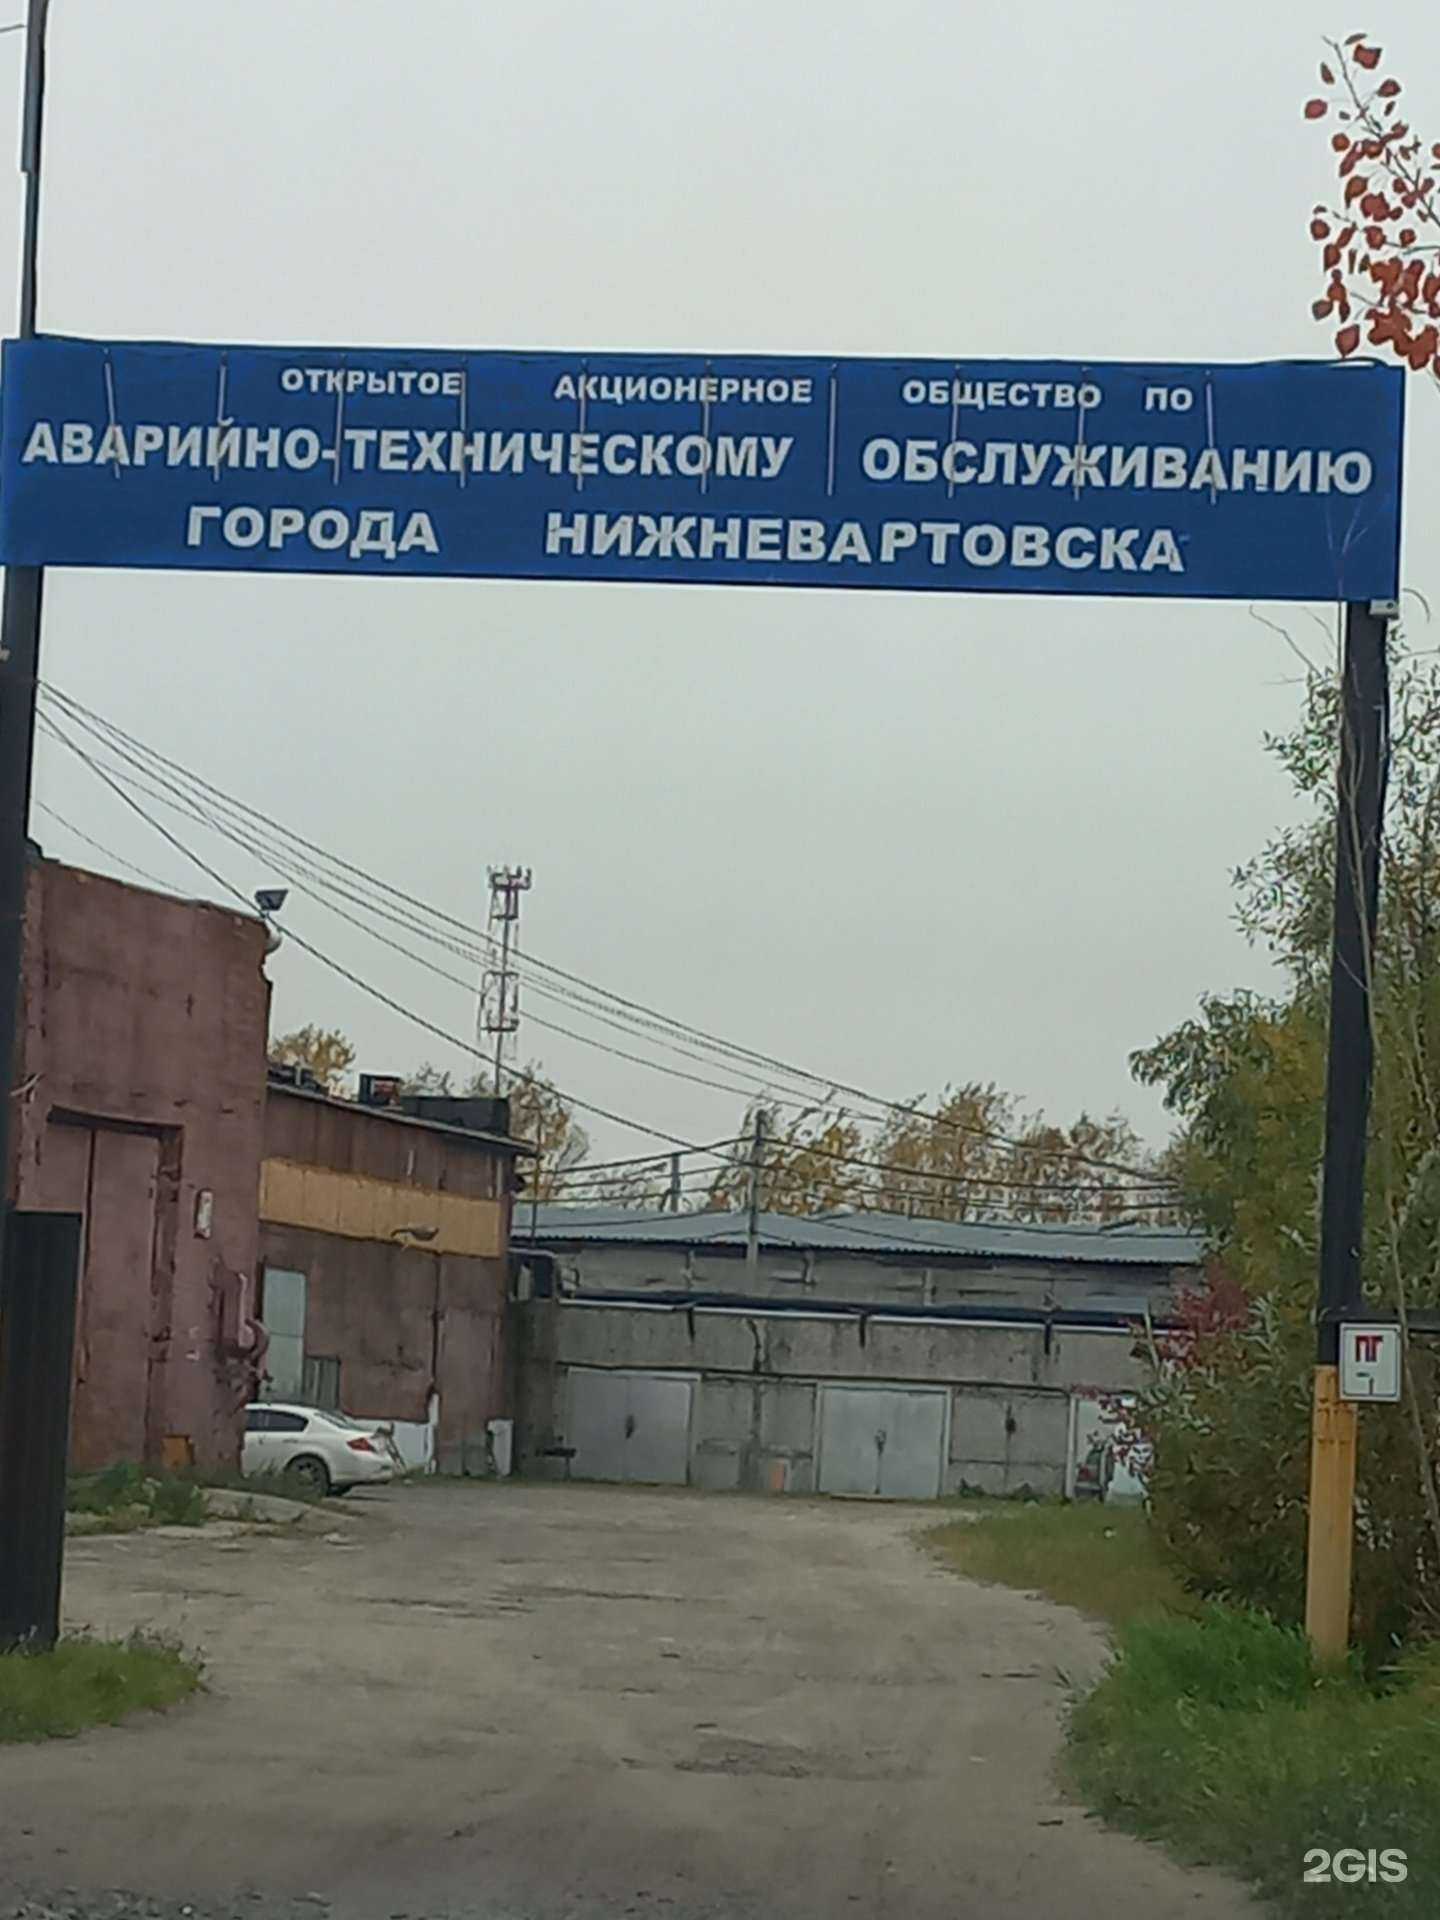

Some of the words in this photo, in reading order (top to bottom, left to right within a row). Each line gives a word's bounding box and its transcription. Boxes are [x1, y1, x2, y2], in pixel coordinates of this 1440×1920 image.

[281, 368, 462, 396] ОТКРЫТОЕ
[554, 374, 813, 405] АКЦИОНЕРНОЕ
[903, 379, 1102, 410] ОБЩЕСТВО
[1145, 387, 1193, 412] ПО
[22, 416, 794, 477] АВАРИЙНО-ТЕХНИЧЕСКОМУ
[862, 438, 1373, 494] ОБСЛУЖИВАНИЮ
[187, 506, 439, 559] ГОРОДА
[545, 511, 1185, 573] НИЖНЕВАРТОВСКА
[1355, 1335, 1384, 1362] ПГ
